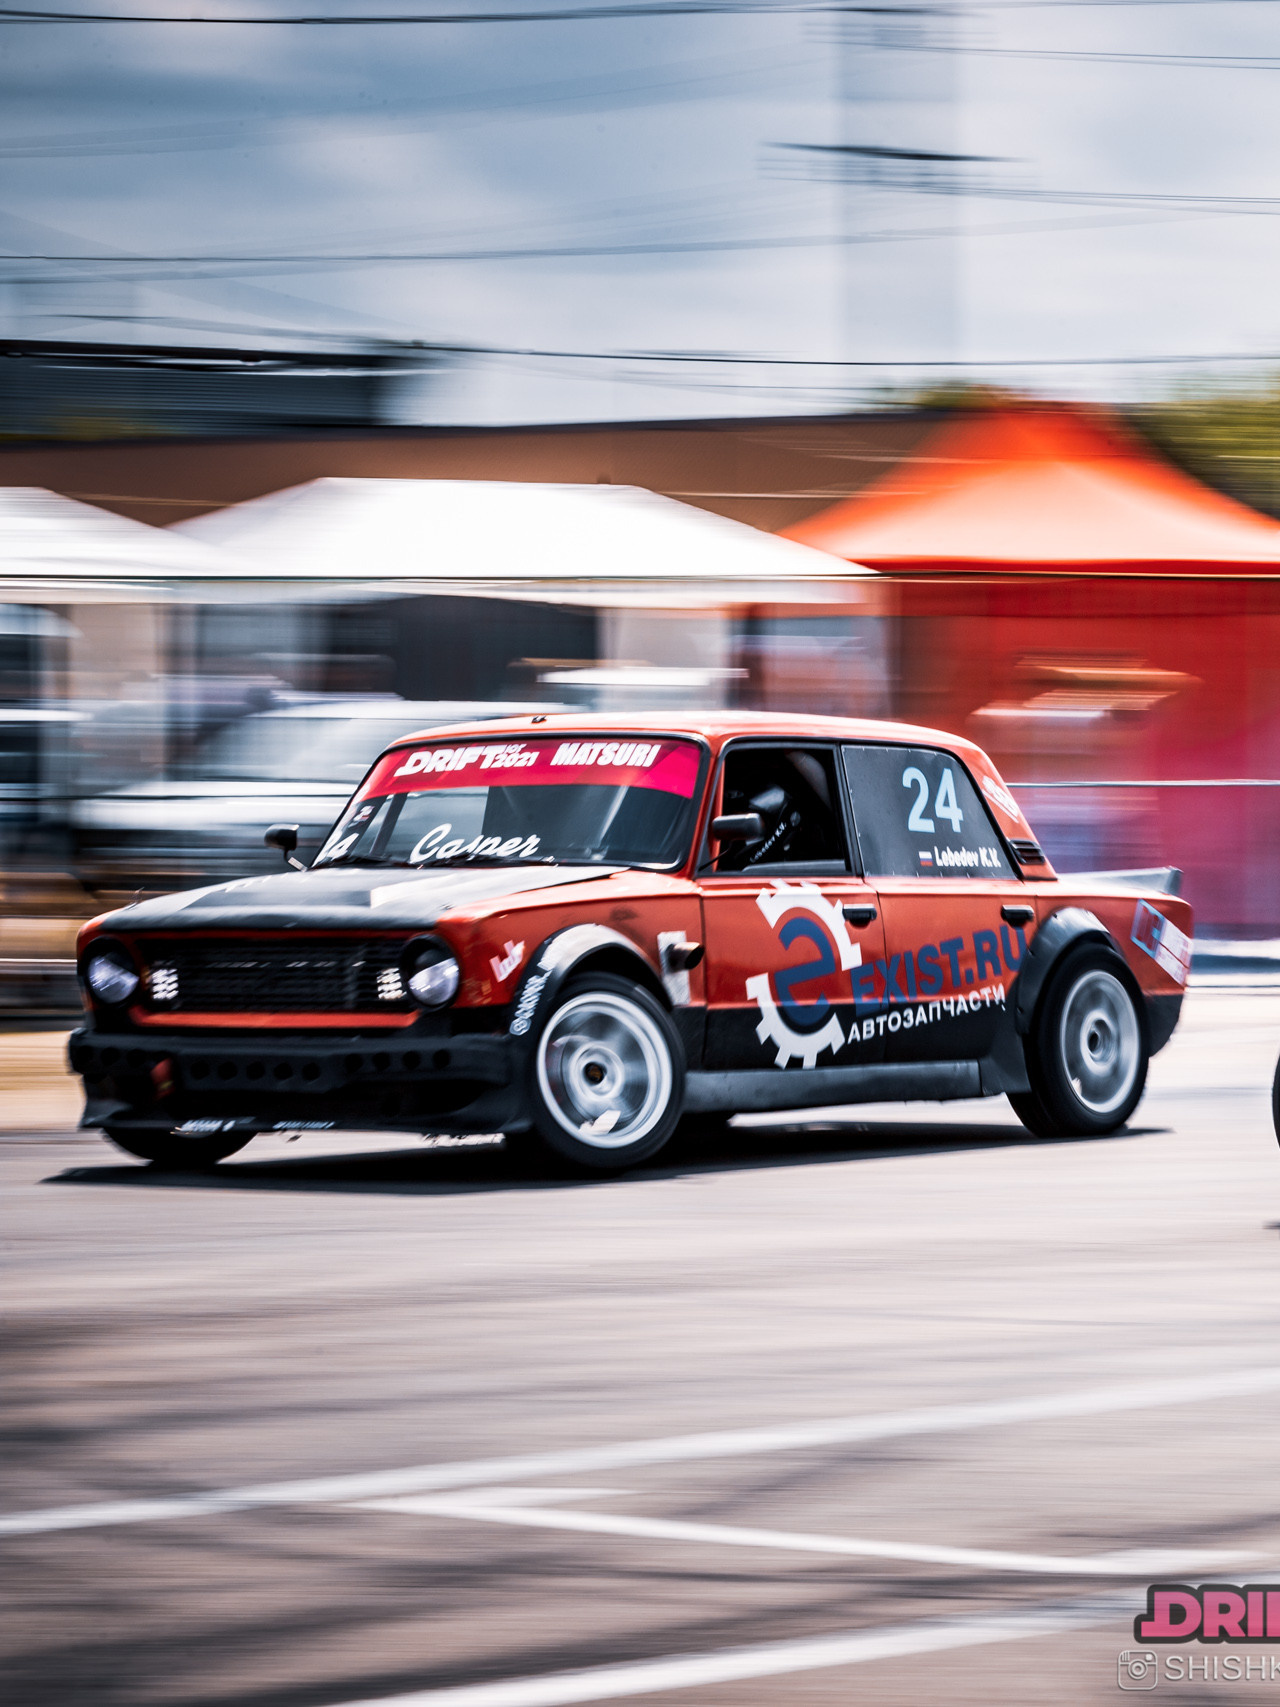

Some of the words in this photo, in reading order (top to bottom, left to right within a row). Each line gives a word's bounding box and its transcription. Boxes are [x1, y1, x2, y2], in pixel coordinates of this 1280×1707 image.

[393, 744, 508, 777] DRIFT
[490, 751, 540, 769] 2021
[550, 743, 661, 767] MATSURI
[902, 766, 964, 833] 24
[408, 823, 541, 864] Casper
[933, 845, 979, 867] Lebedev
[850, 923, 1027, 1018] EXIST.RU
[847, 982, 1007, 1044] АВТОЗАПЧАСТИ
